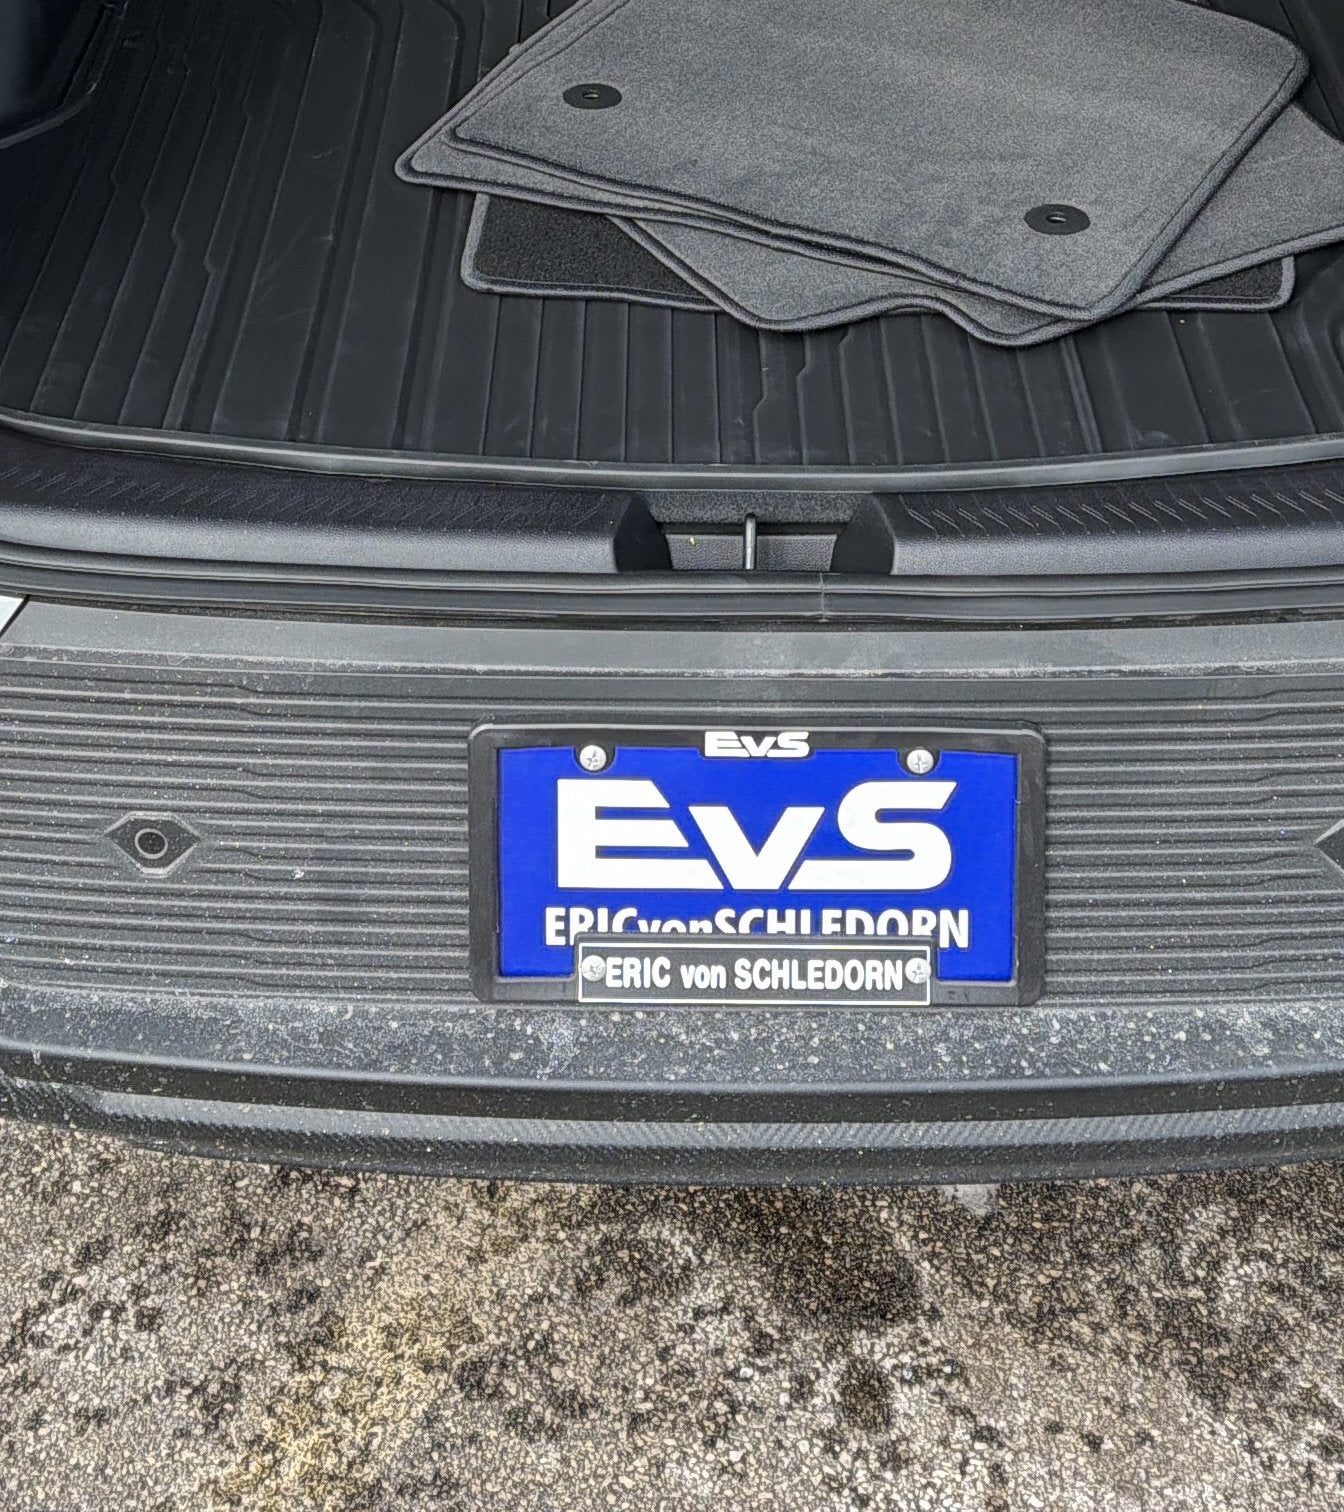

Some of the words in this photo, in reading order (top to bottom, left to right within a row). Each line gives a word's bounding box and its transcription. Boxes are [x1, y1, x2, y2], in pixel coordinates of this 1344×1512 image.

[605, 956, 671, 989] ERIC
[680, 964, 727, 989] von
[734, 958, 903, 991] SCHLEDORN
